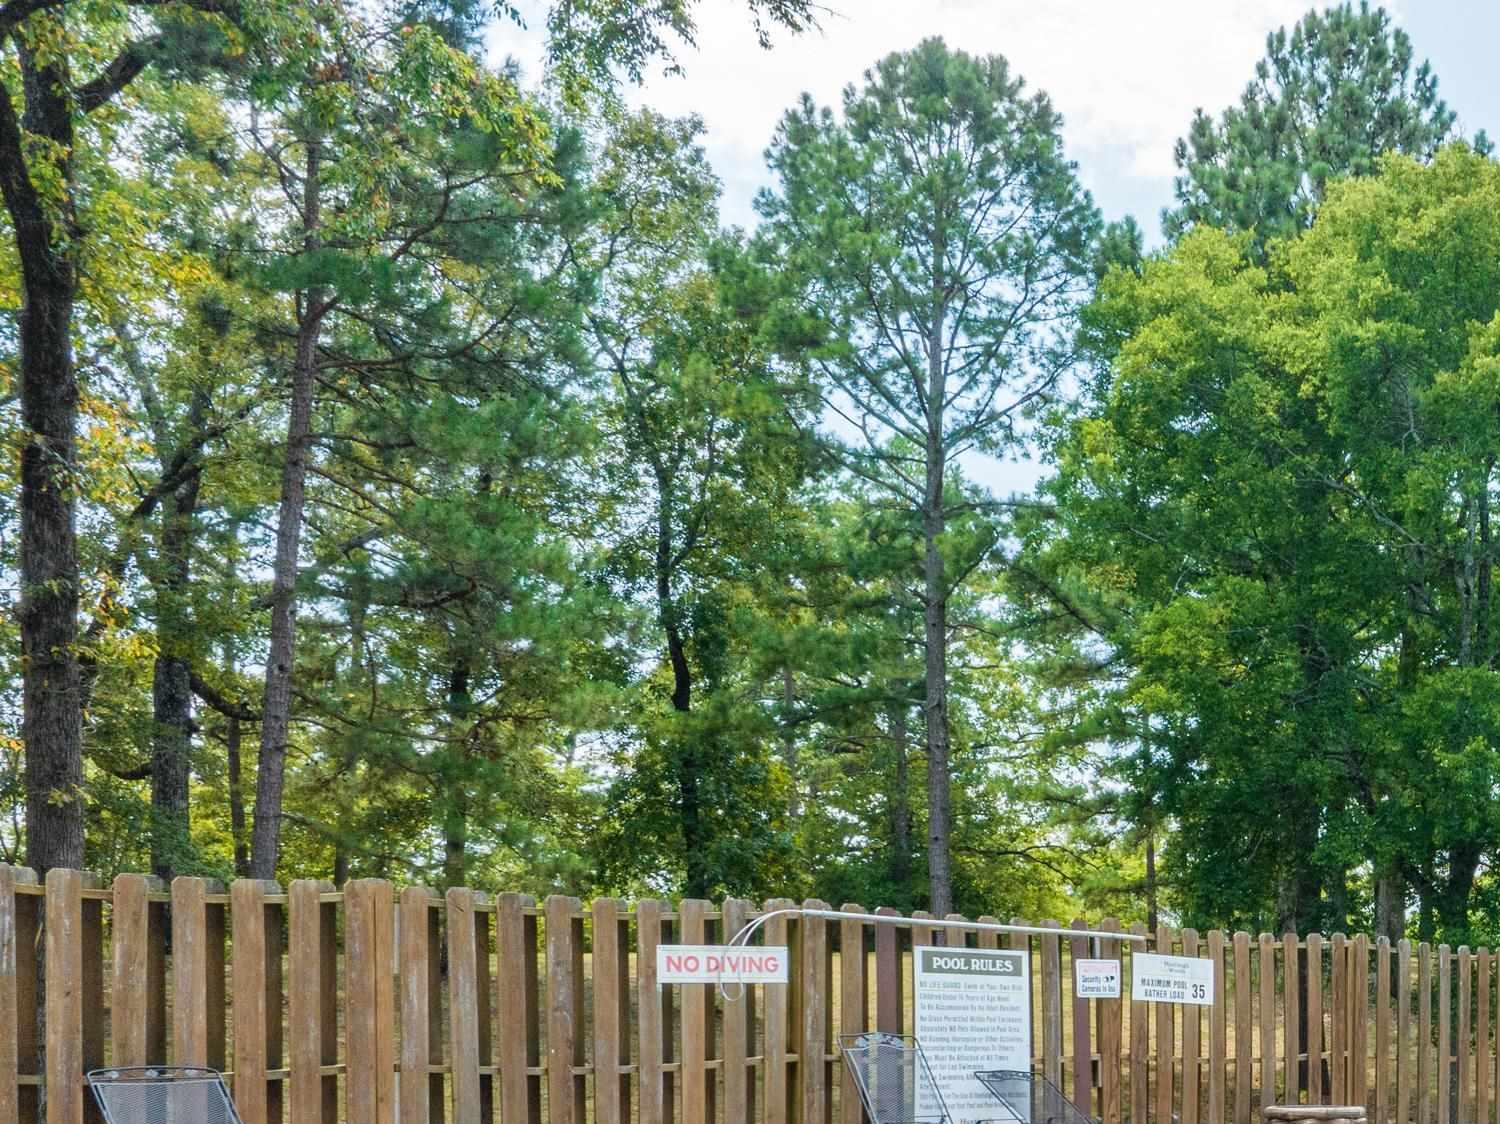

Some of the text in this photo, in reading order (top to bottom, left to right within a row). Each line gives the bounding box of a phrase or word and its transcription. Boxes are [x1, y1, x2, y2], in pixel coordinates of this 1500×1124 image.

[665, 954, 779, 973] NO DIVING
[932, 956, 1014, 972] POOL RULES
[1140, 977, 1188, 990] MAXIMUM POOL
[1191, 983, 1206, 999] 35
[1144, 988, 1185, 999] BATHER LOAD
